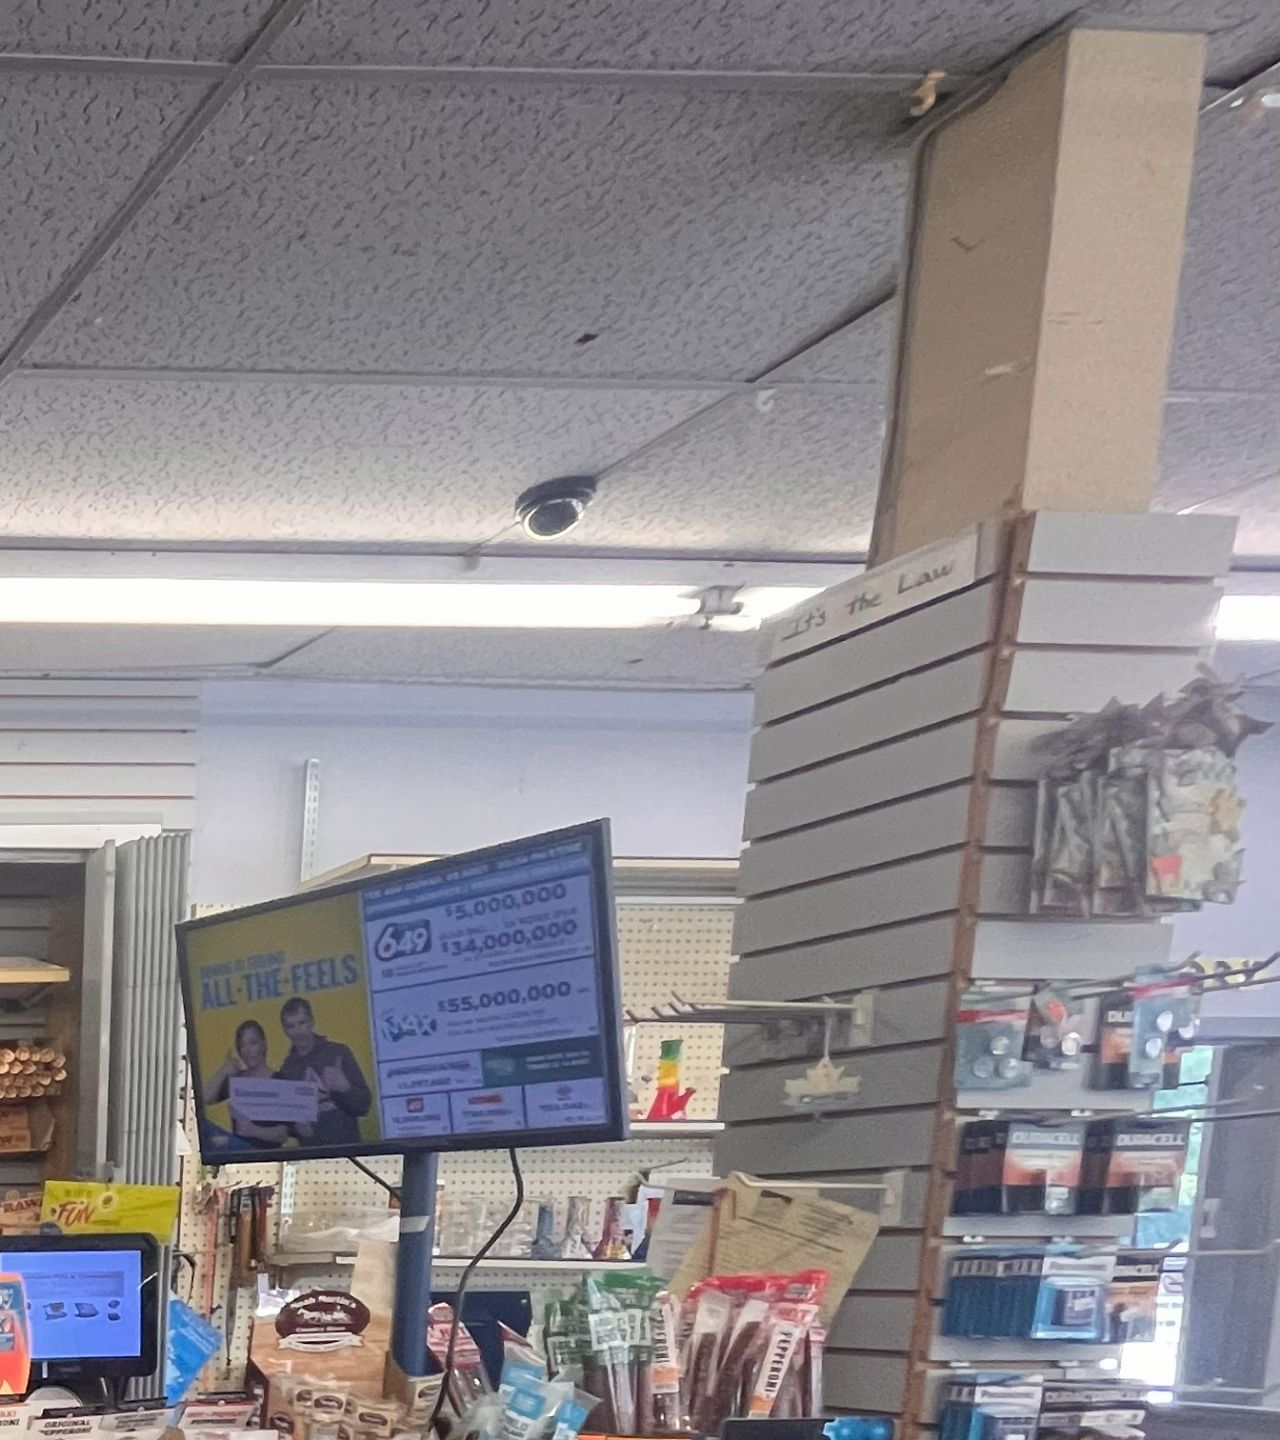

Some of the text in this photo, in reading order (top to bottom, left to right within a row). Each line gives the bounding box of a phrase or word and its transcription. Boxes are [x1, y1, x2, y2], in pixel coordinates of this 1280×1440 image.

[782, 561, 954, 640] It's the Law
[444, 883, 567, 921] $5,000,000
[440, 919, 578, 957] $34,000,000
[243, 968, 283, 1001] THE
[290, 954, 358, 993] FEELS
[438, 981, 572, 1013] $55,000,000
[764, 1331, 792, 1393] PEPPERONI
[43, 1419, 91, 1431] ORIGINAL
